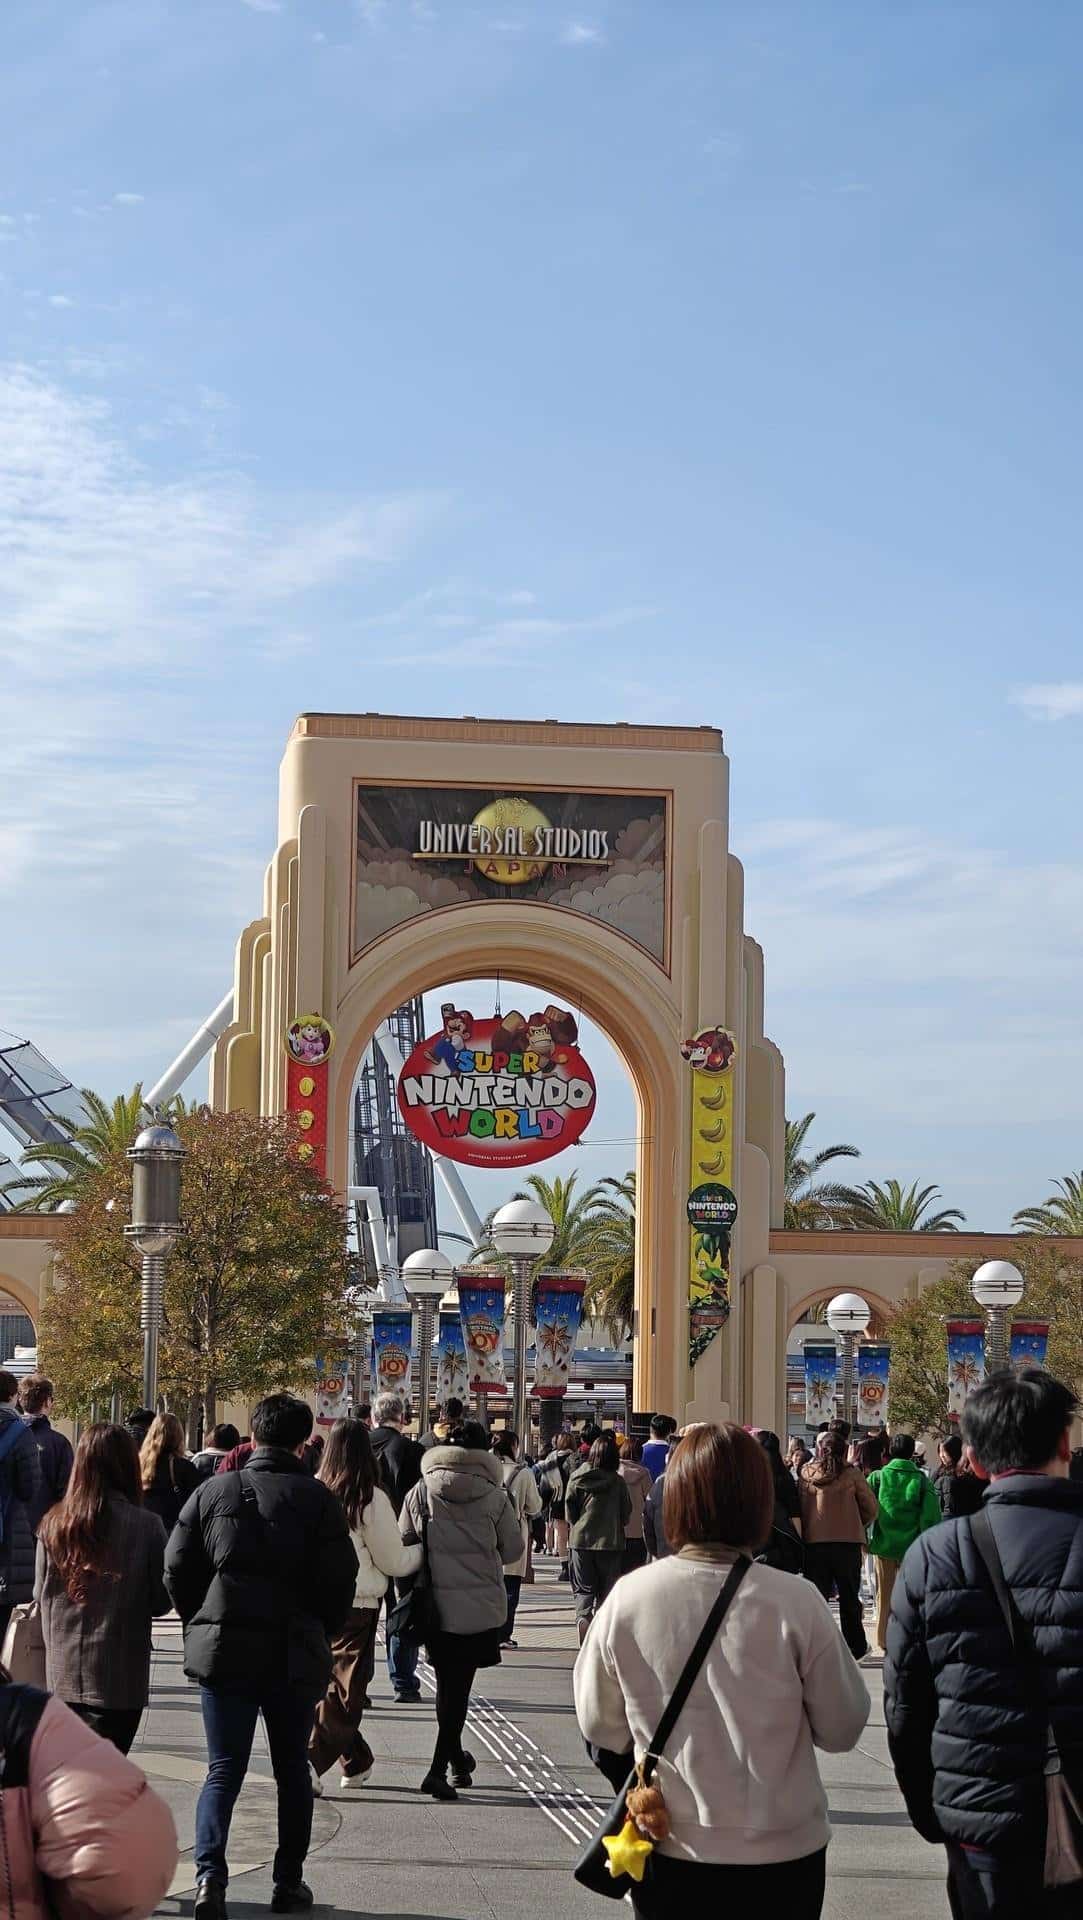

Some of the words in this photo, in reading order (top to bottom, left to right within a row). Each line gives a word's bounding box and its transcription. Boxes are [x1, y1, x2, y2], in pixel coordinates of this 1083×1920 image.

[419, 820, 528, 856] UNIVERSAL
[534, 827, 609, 859] STUDIOS
[464, 859, 568, 879] JAPAN
[457, 1049, 541, 1074] SUPER
[402, 1075, 594, 1109] NINTENDO
[431, 1108, 565, 1140] WORLD
[688, 1201, 737, 1211] NINTENDO
[695, 1210, 729, 1219] WORLD
[379, 1359, 409, 1373] JOY
[319, 1378, 344, 1390] JOY
[860, 1386, 885, 1398] JOY
